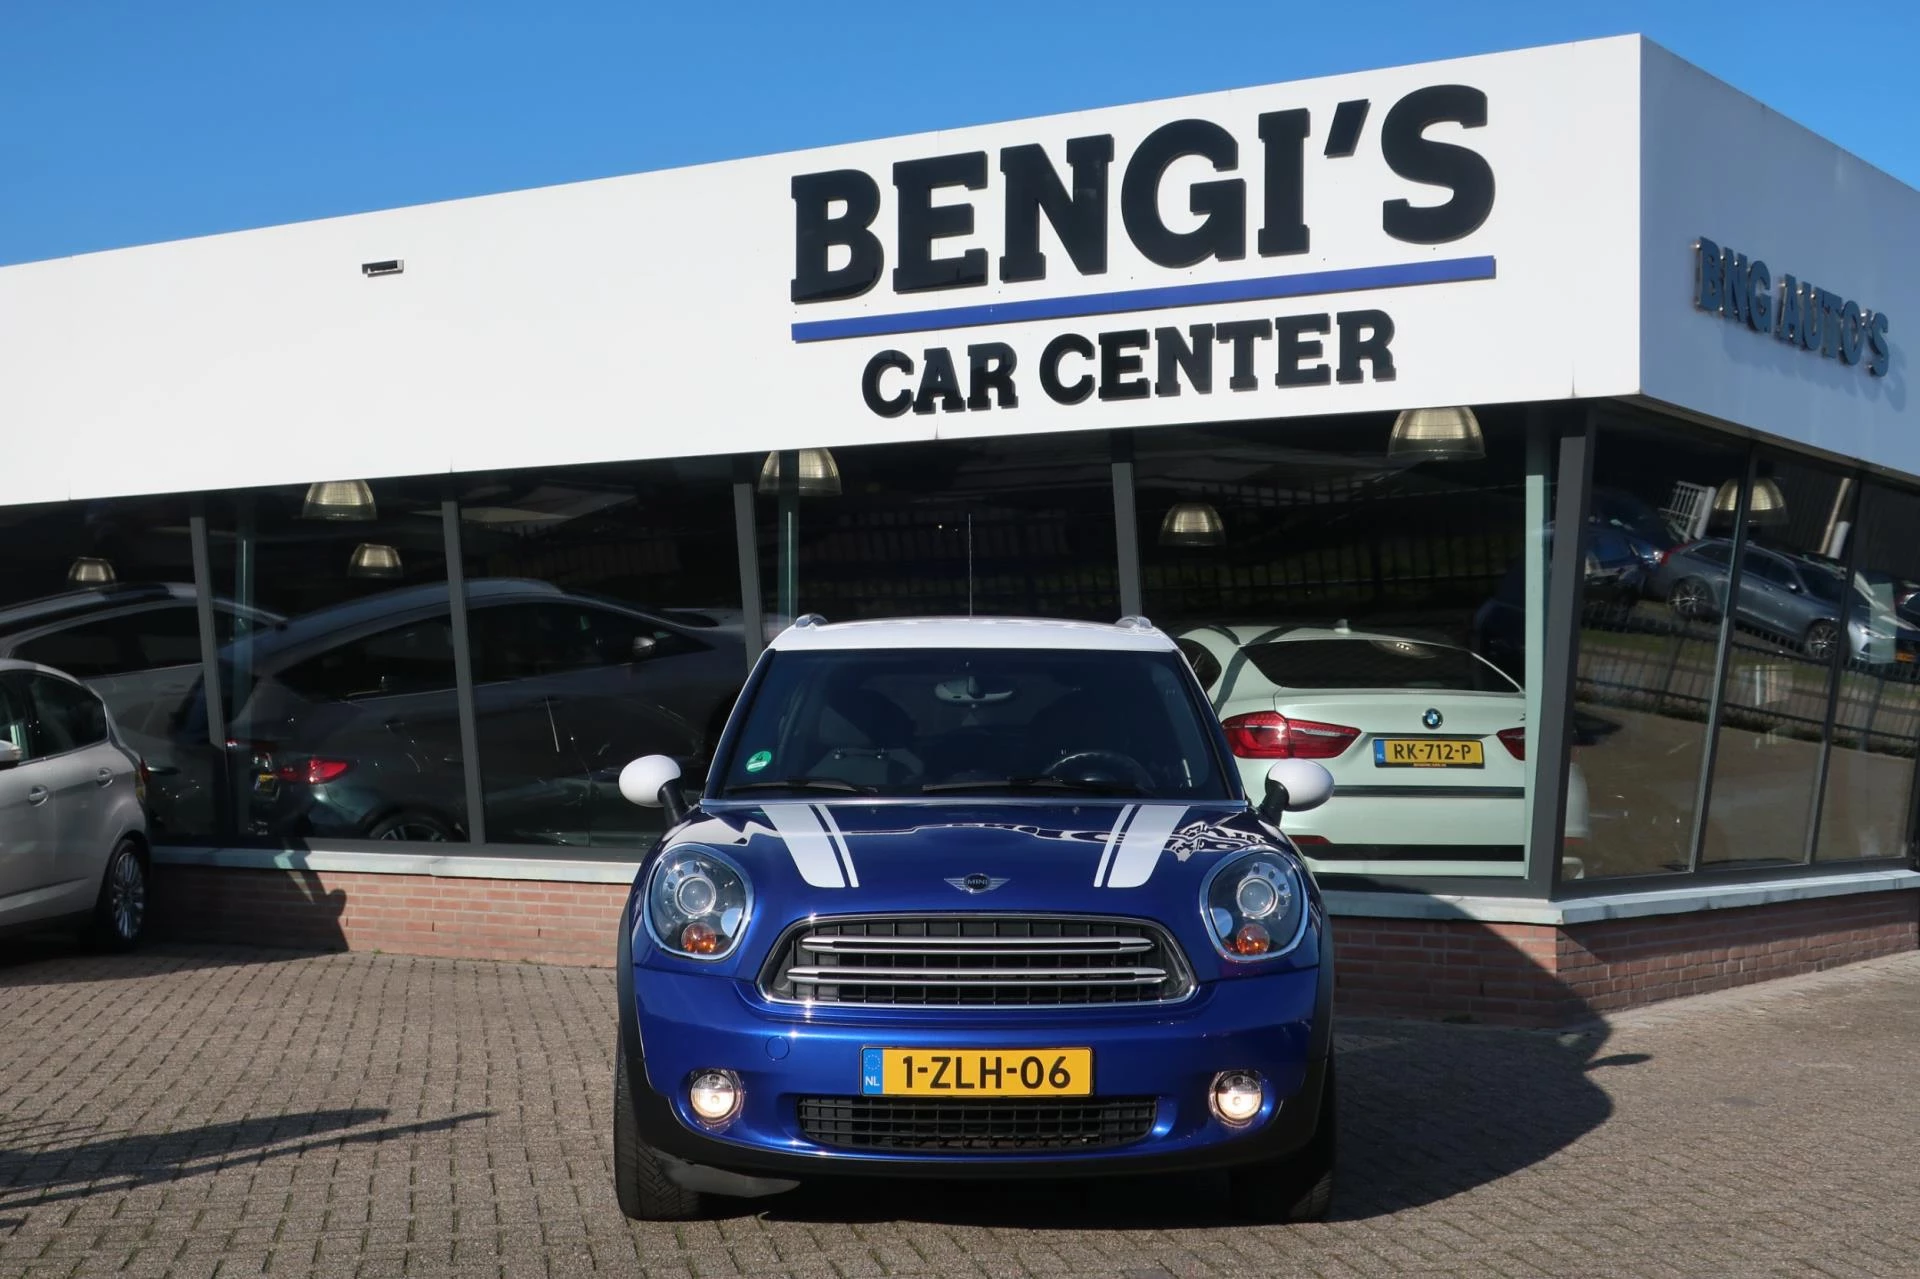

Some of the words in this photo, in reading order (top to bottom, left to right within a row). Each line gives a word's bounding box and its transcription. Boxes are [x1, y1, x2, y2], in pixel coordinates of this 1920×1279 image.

[790, 83, 1496, 305] BENGI'S
[1694, 236, 1772, 334] BNG
[1776, 273, 1890, 377] AUTO'S
[861, 340, 1019, 418] CAR
[1039, 308, 1397, 405] CENTER
[1393, 743, 1472, 760] RK-712-P
[865, 1077, 880, 1087] NL
[902, 1056, 1071, 1089] 1-ZLH-06
